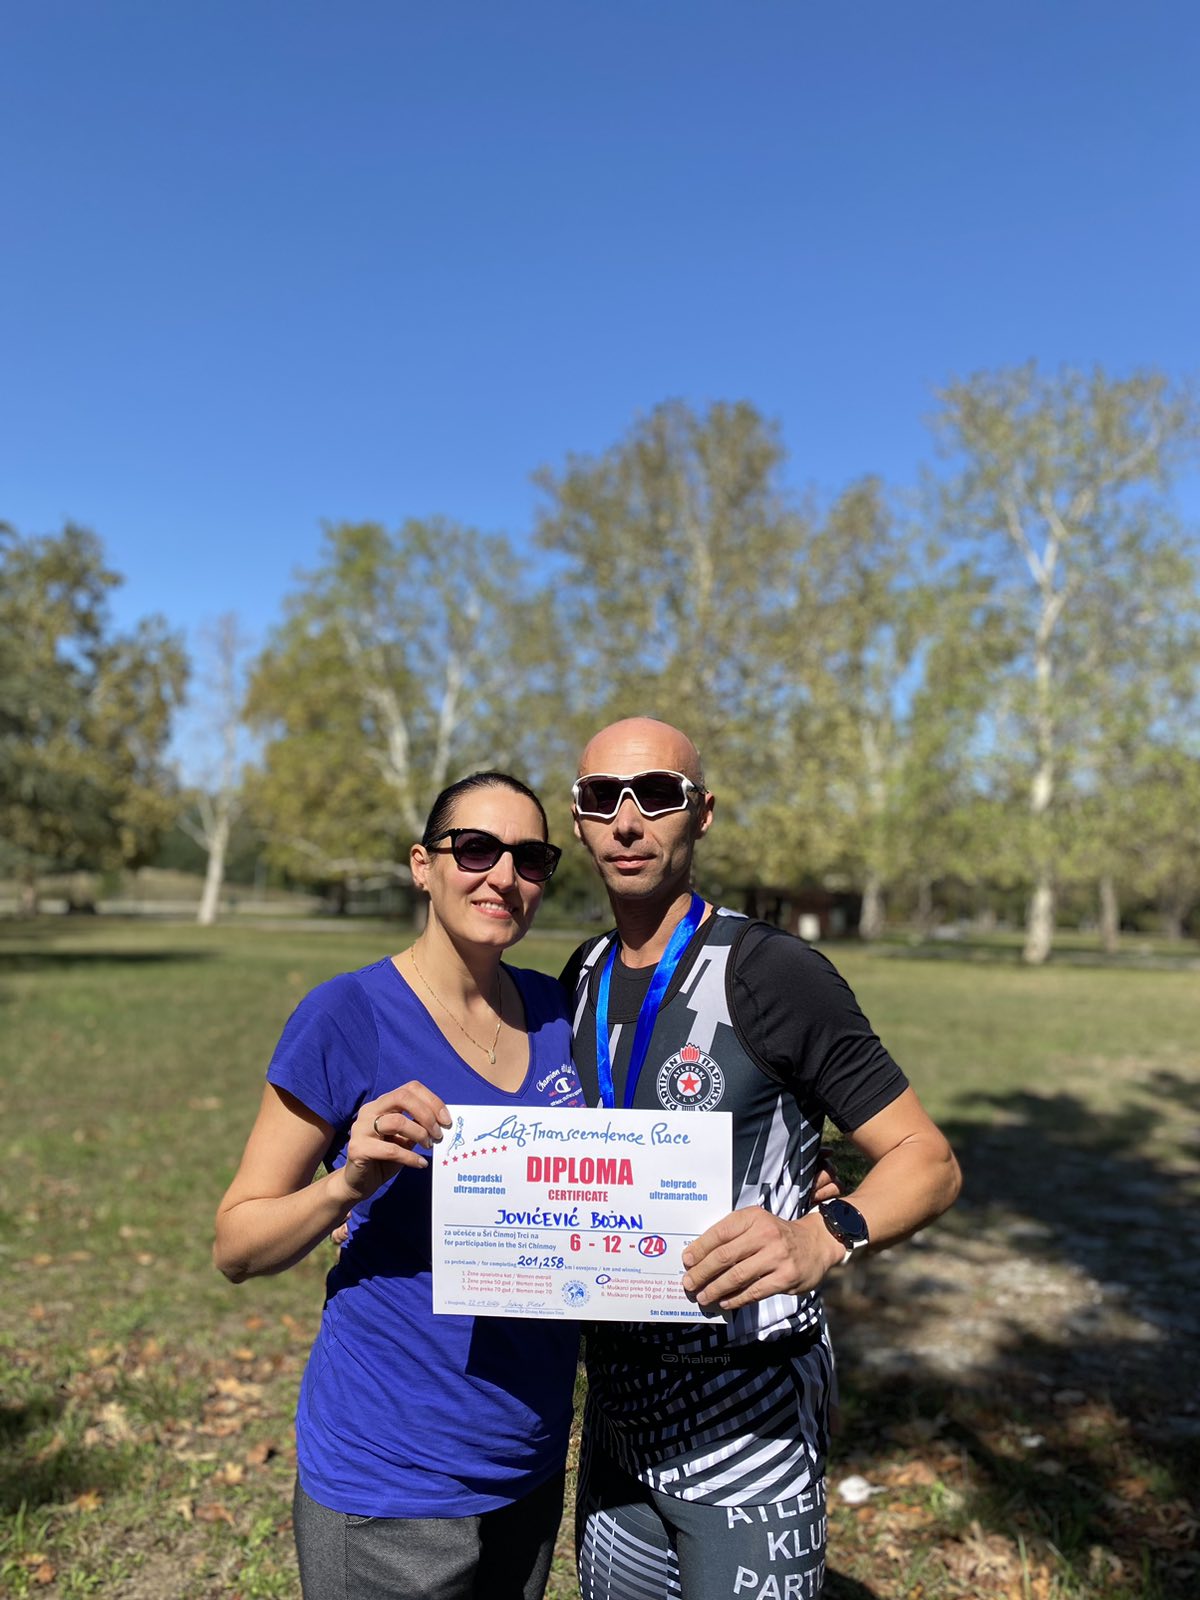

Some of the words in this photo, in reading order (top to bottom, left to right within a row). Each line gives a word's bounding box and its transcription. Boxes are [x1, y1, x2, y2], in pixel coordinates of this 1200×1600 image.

[673, 1066, 706, 1080] ATLETSKI
[660, 1058, 679, 1111] PARTIZAN
[699, 1058, 722, 1111] ПАРТИЗАН
[676, 1094, 702, 1102] KLUB
[651, 1122, 691, 1145] Race
[526, 1156, 634, 1185] DIPLOMA
[457, 1173, 502, 1184] beogradski
[660, 1179, 697, 1189] belgrade
[453, 1185, 506, 1195] ultramaraton
[548, 1189, 608, 1202] CERTIFICATE
[649, 1191, 708, 1201] ultramarathon
[494, 1207, 580, 1226] JOVIĆEVIĆ
[528, 1242, 556, 1251] Chinmoy
[570, 1233, 581, 1252] 6
[602, 1235, 622, 1253] 12
[644, 1236, 665, 1254] 24
[517, 1255, 564, 1269] 201,258
